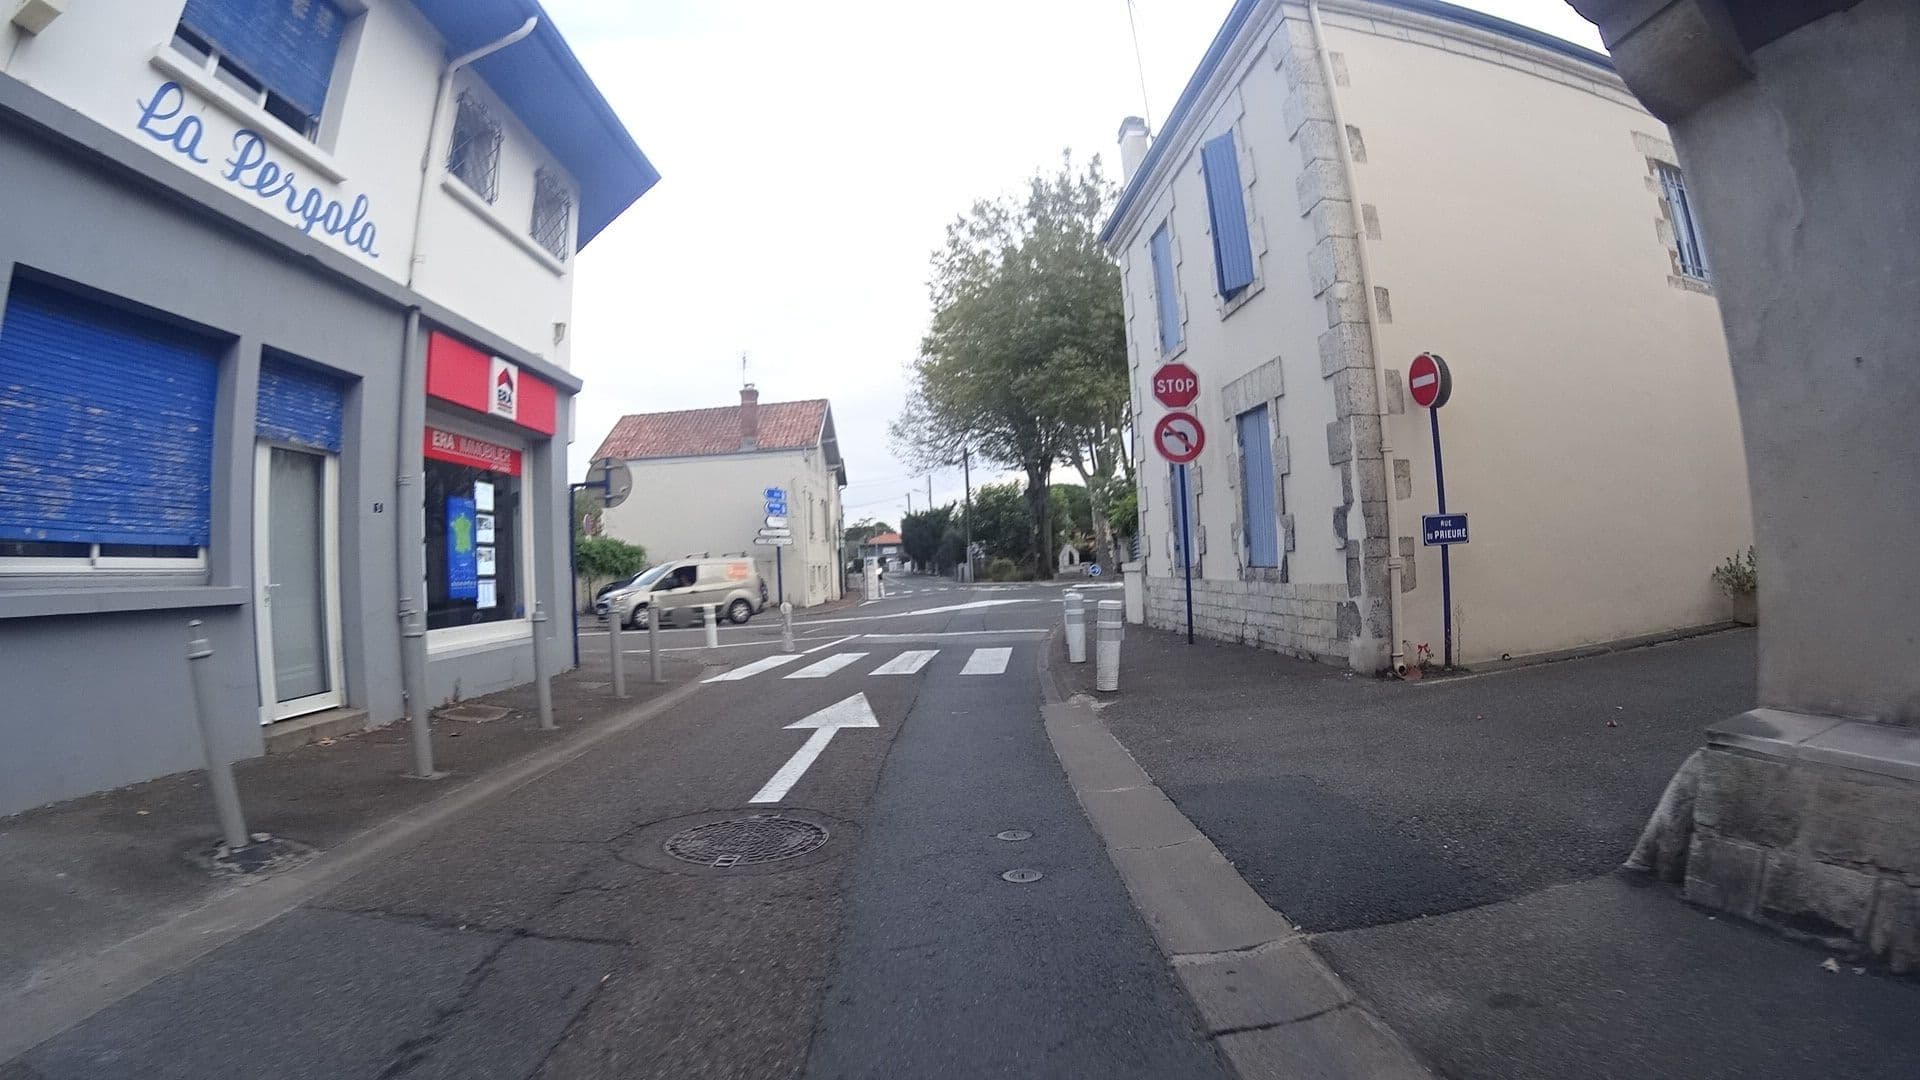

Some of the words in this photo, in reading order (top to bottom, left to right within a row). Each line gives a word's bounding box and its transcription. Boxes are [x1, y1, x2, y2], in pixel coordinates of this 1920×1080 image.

[137, 81, 208, 164] La
[221, 128, 379, 258] Pergola
[1156, 379, 1194, 394] STOP
[432, 430, 455, 450] ERA
